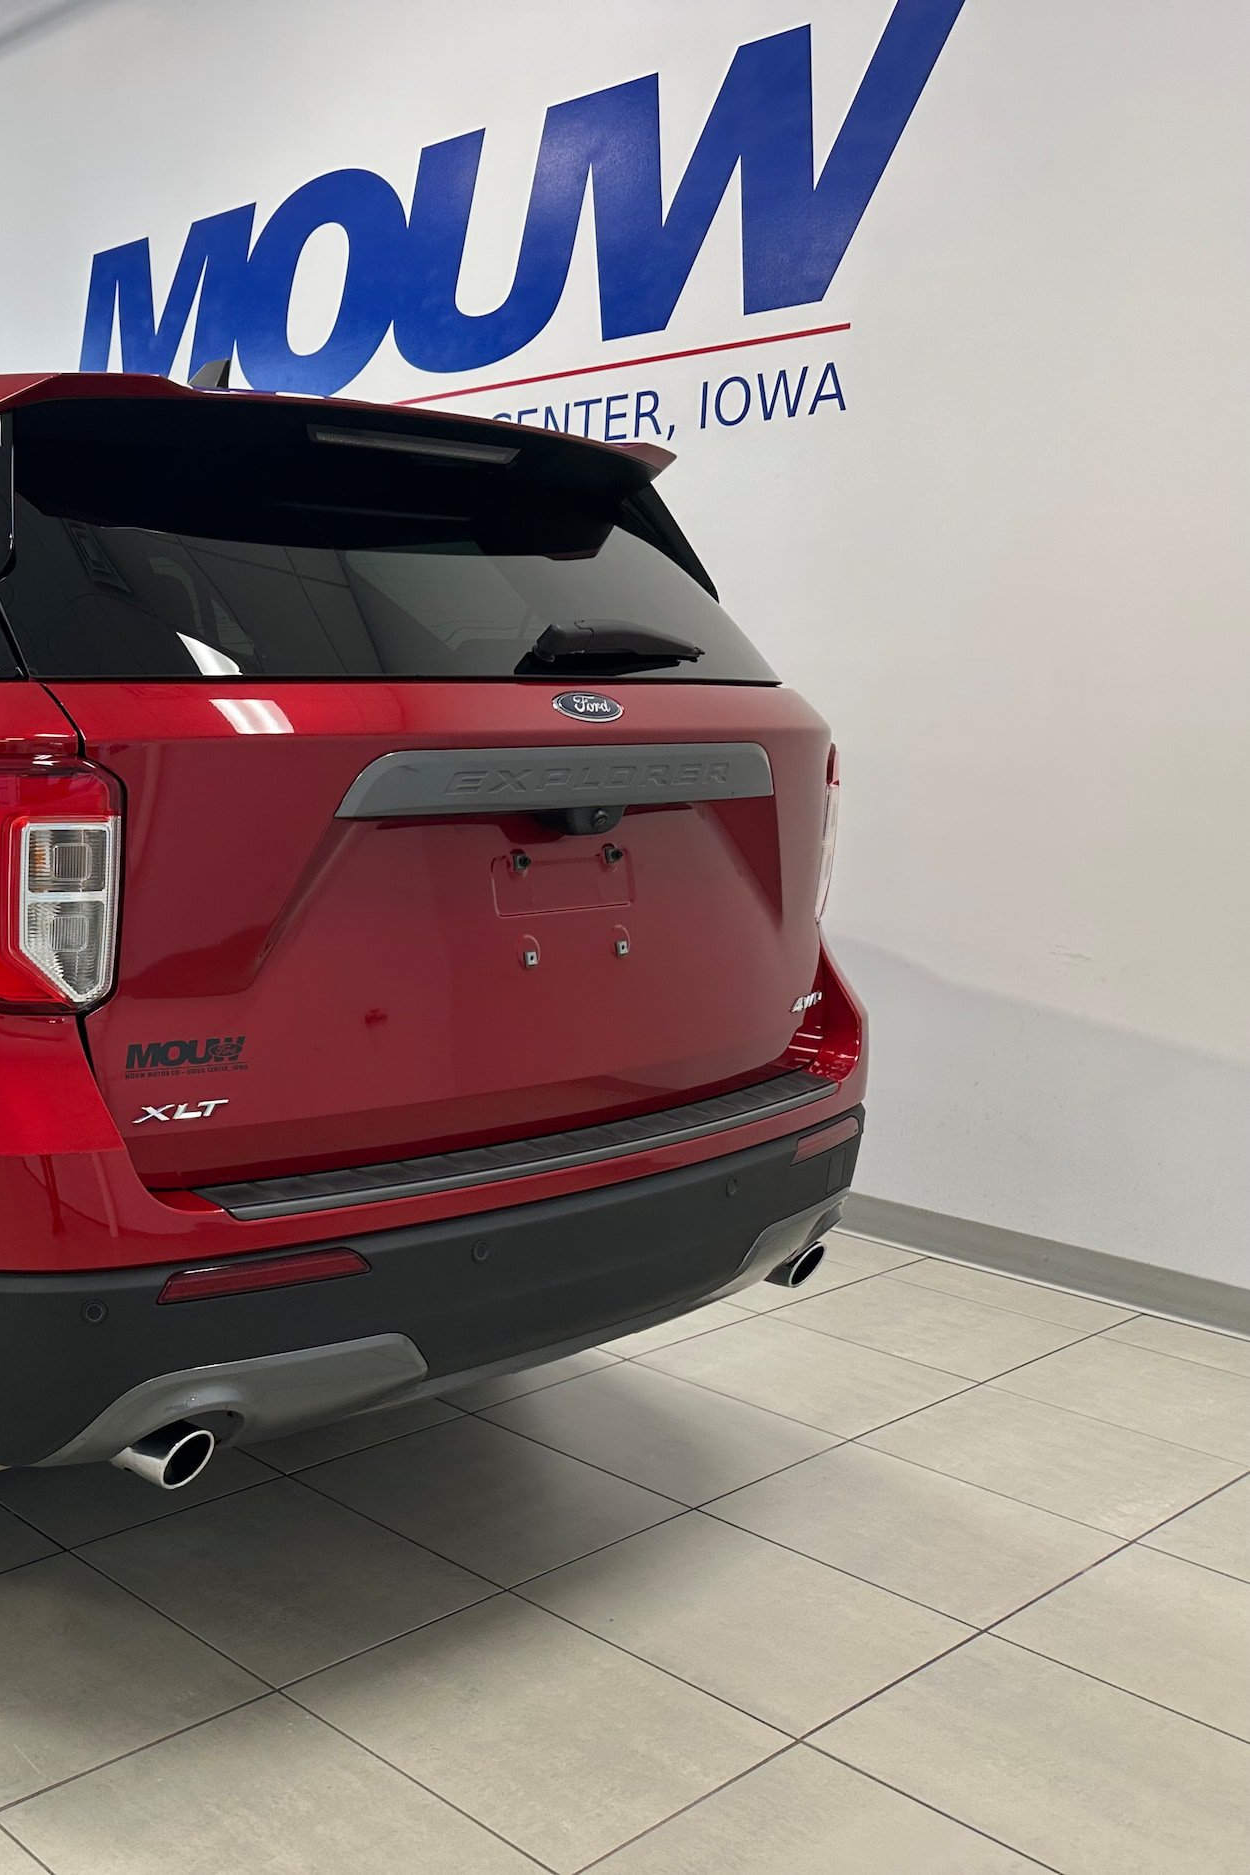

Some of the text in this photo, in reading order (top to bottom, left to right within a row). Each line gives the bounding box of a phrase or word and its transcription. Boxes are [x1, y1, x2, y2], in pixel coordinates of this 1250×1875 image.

[80, 0, 962, 398] MOUW
[493, 362, 847, 441] NTER, IOWA
[572, 695, 611, 713] Ford
[443, 762, 731, 796] EXPLORER
[125, 1036, 246, 1069] MOUW
[132, 1098, 230, 1124] XLT
